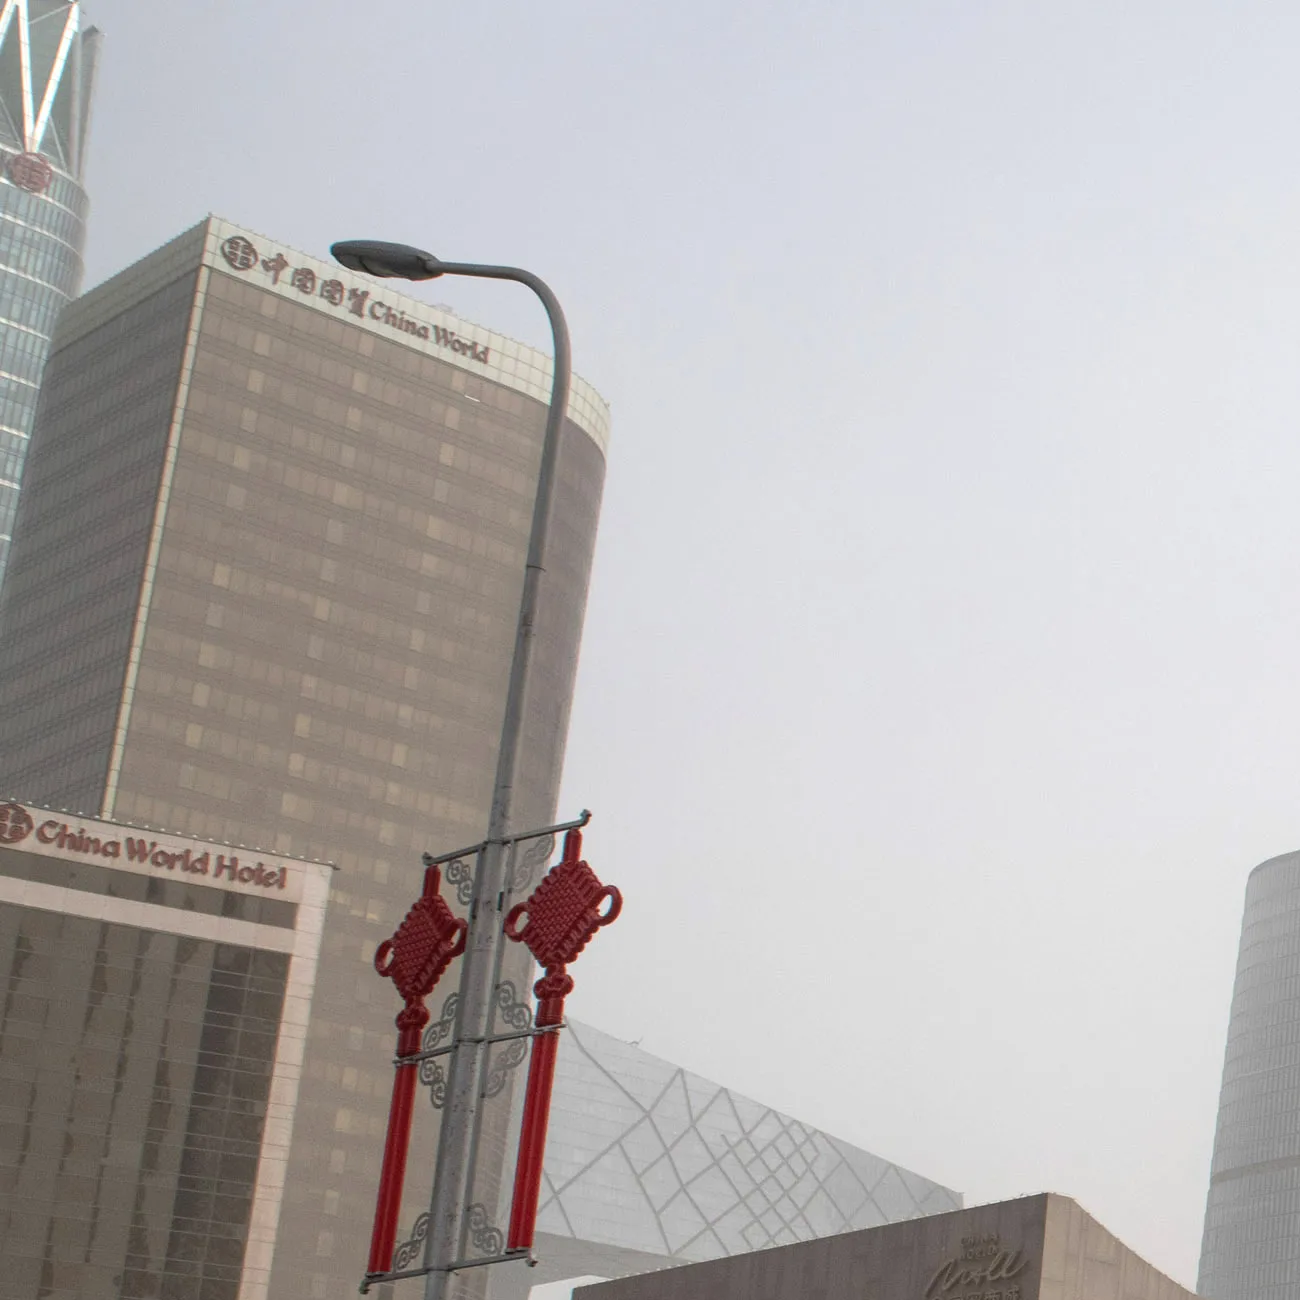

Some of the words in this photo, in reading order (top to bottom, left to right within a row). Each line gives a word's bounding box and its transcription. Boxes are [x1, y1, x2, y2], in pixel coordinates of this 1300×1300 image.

[369, 301, 430, 340] China
[432, 324, 490, 365] World
[36, 819, 121, 858] China
[125, 836, 209, 876] World
[213, 854, 287, 889] Hotel
